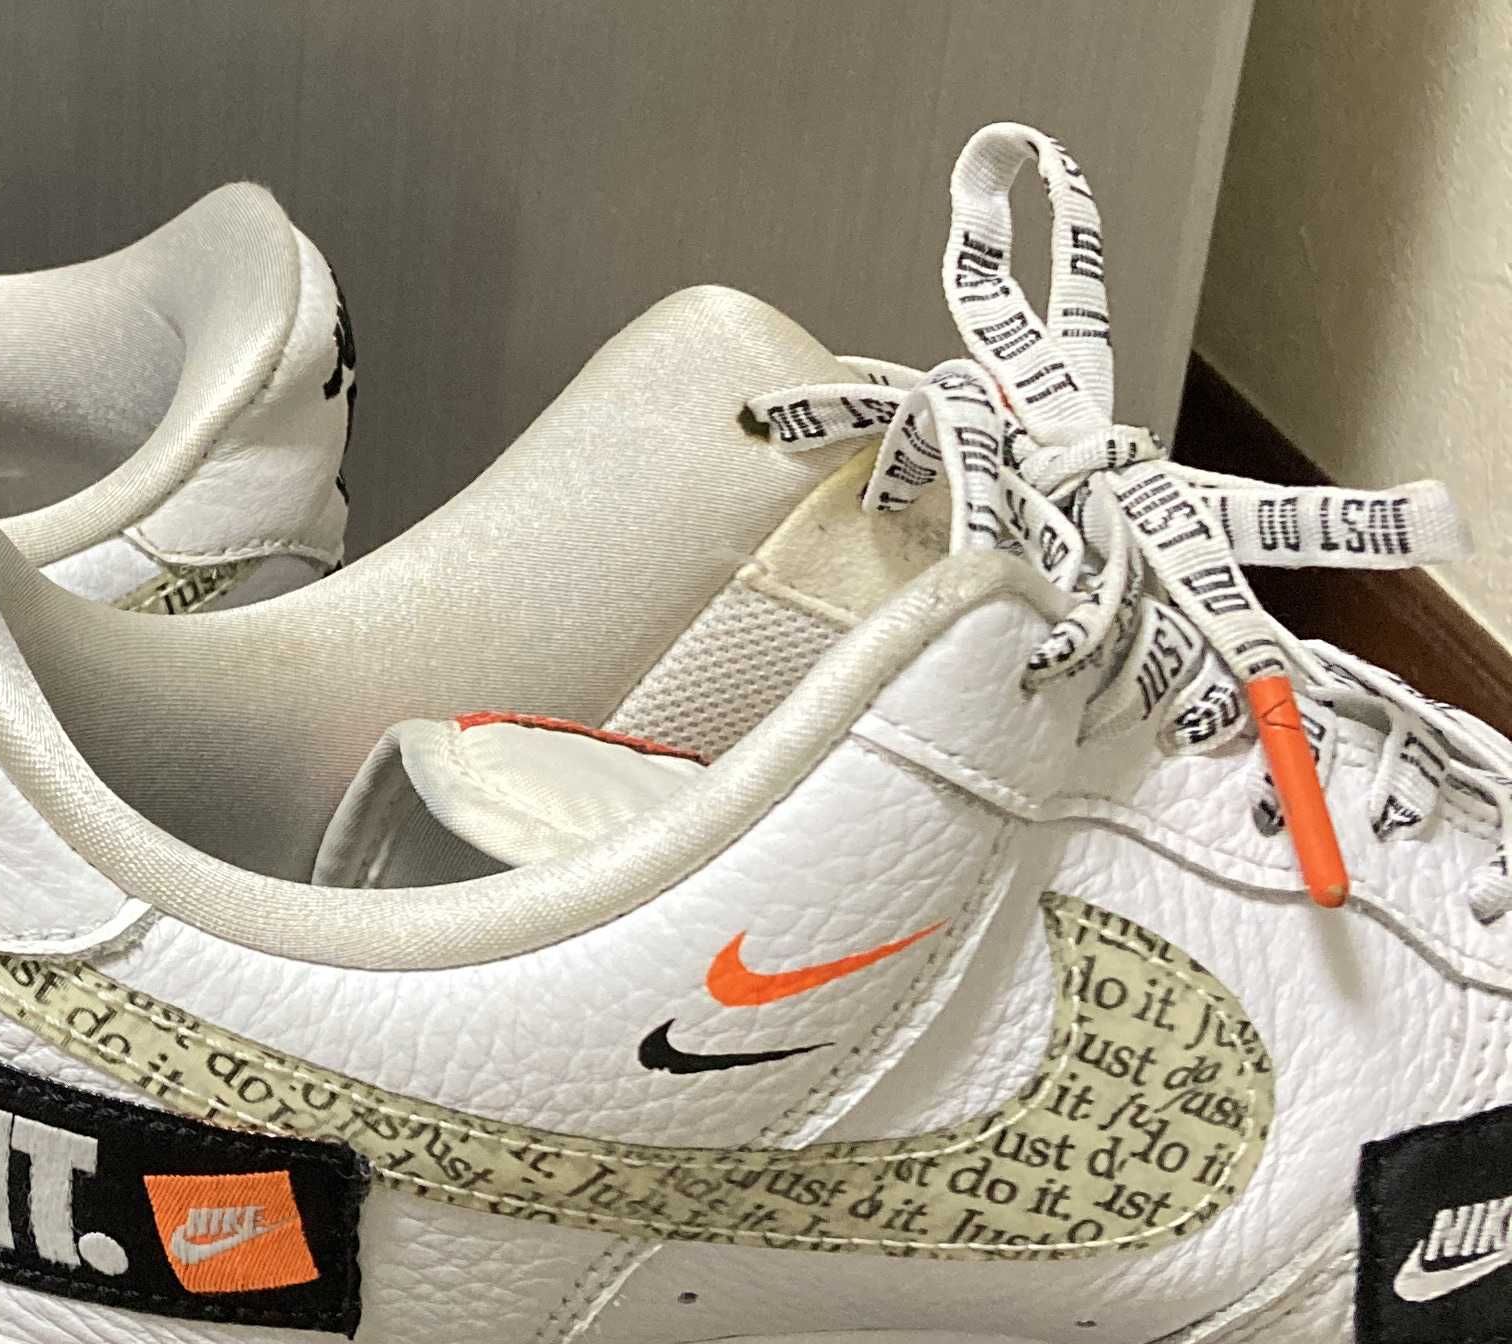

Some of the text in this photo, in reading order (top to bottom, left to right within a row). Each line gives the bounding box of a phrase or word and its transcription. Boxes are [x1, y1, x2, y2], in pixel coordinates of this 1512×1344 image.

[1115, 473, 1213, 550] JUST
[1180, 565, 1251, 616] DO
[1257, 497, 1301, 552] DO
[1319, 497, 1413, 555] JUST
[947, 1156, 1019, 1205] do
[185, 1205, 265, 1236] NIKE
